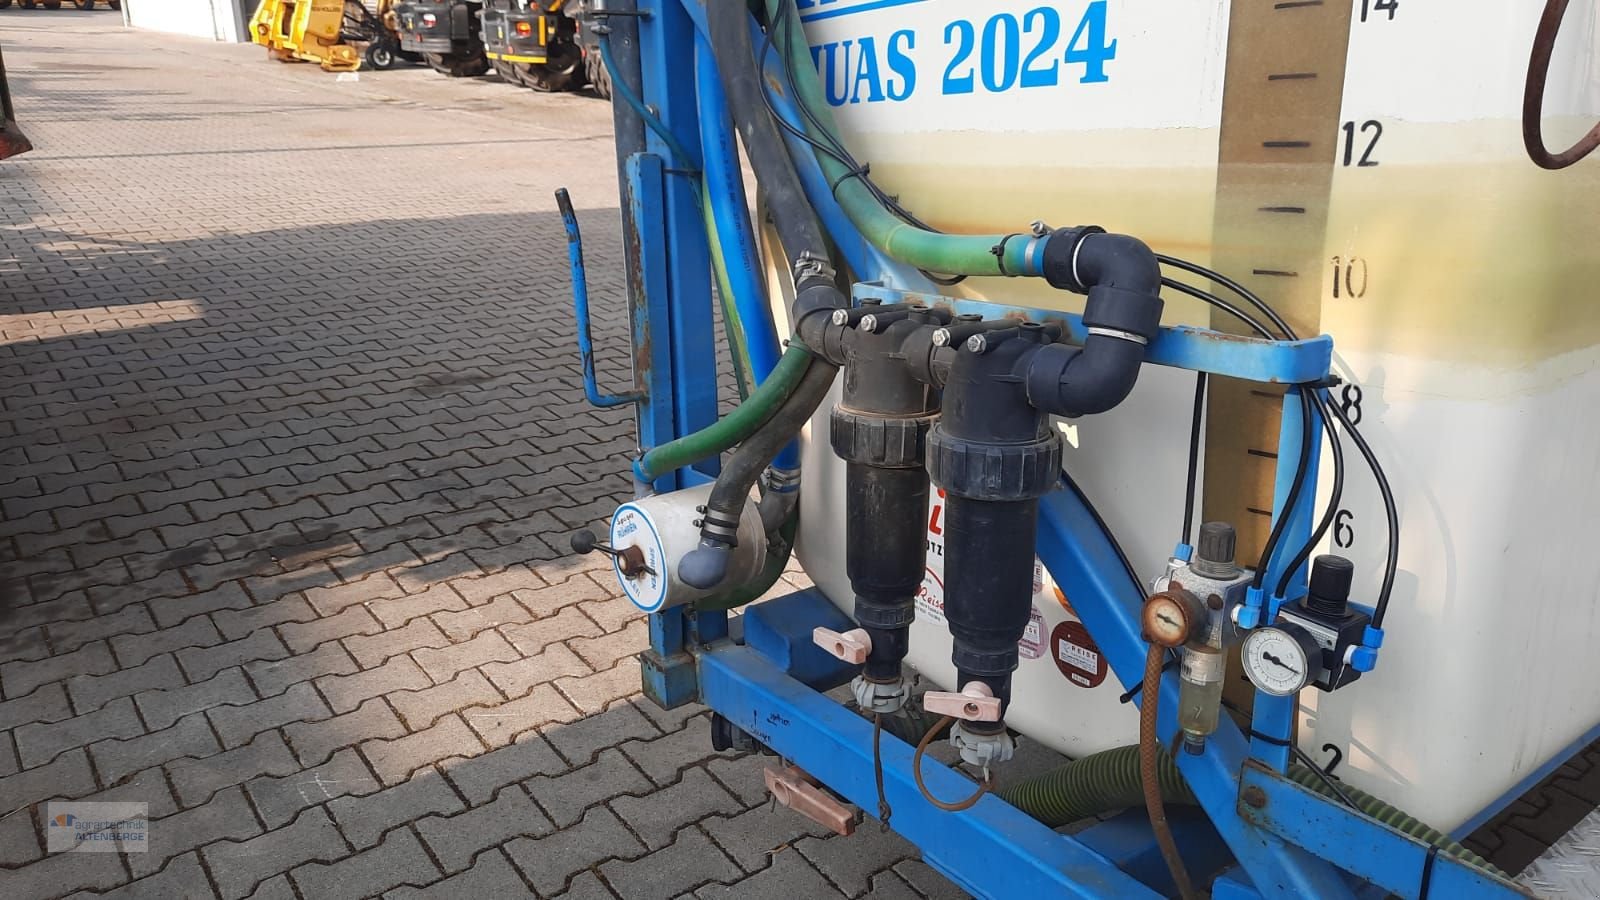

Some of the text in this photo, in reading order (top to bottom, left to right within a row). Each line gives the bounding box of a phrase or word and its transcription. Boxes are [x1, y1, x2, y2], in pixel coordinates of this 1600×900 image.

[810, 0, 1117, 107] UAS 2024
[1342, 119, 1383, 167] 12
[1331, 255, 1368, 299] 10
[1342, 384, 1362, 426] 8
[1334, 509, 1354, 549] 6
[1322, 743, 1342, 781] 2
